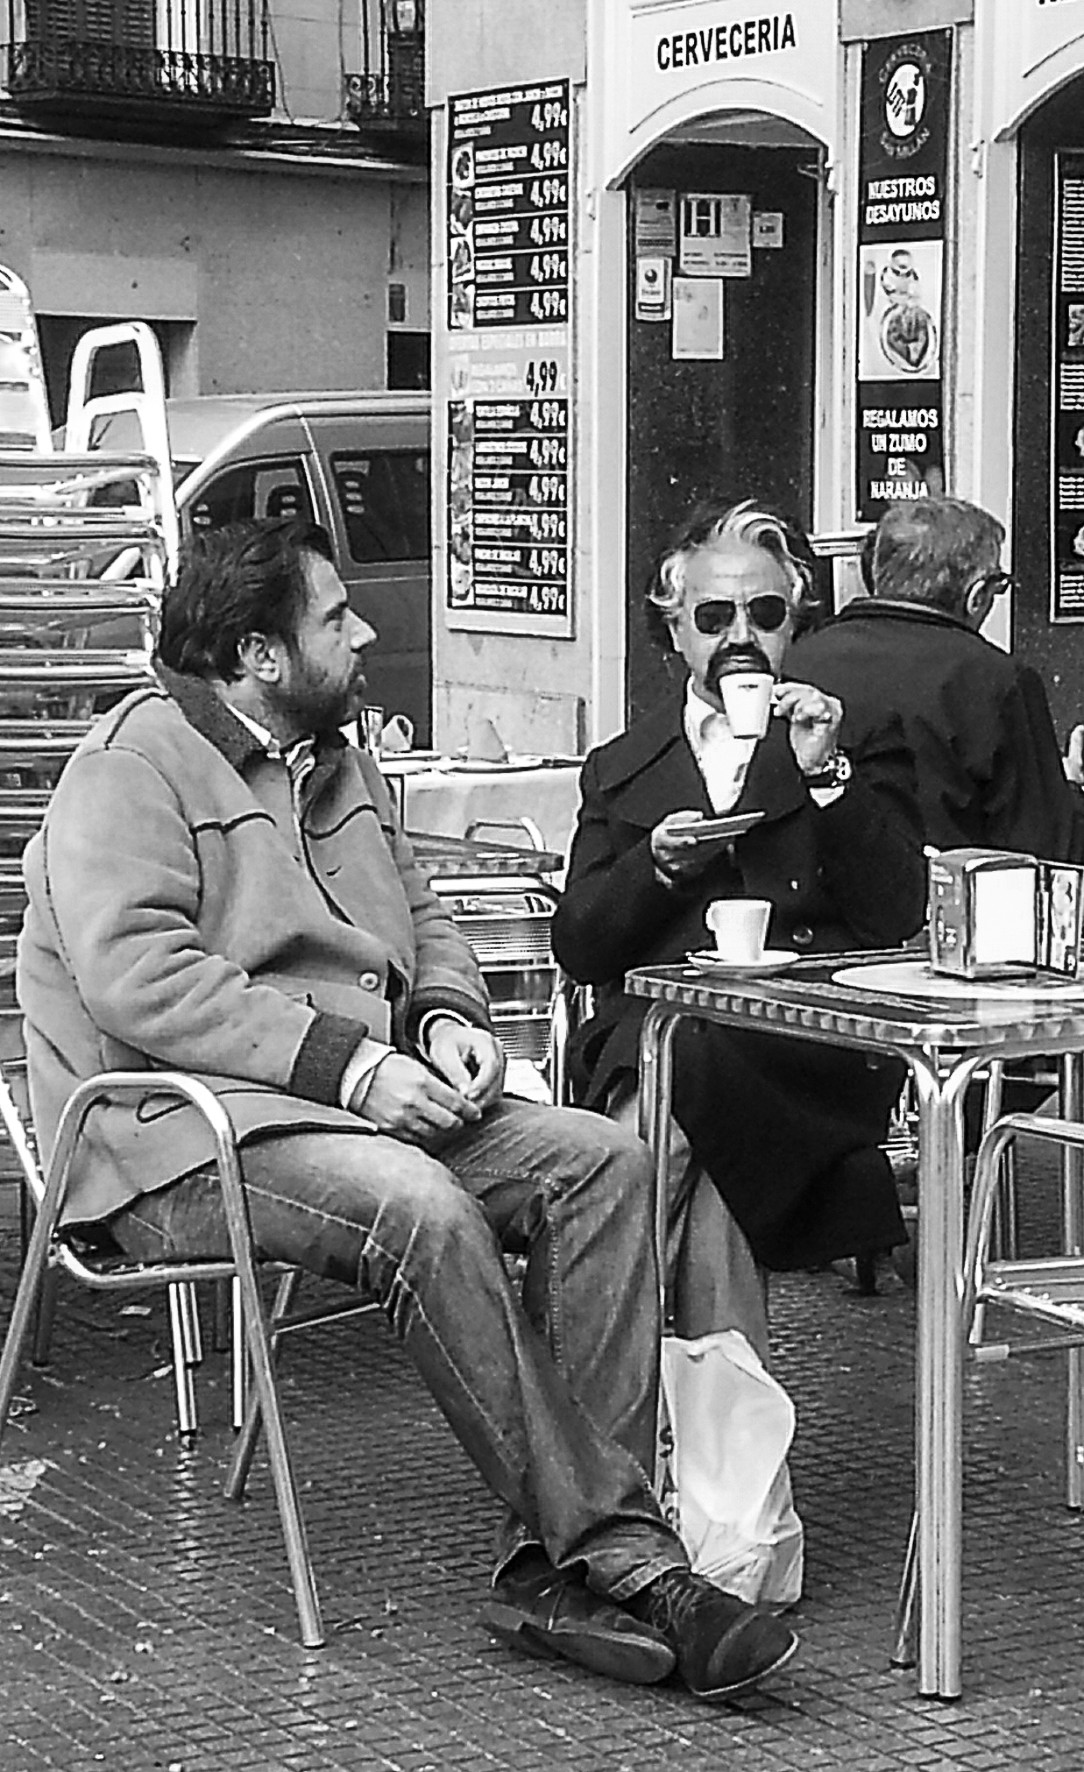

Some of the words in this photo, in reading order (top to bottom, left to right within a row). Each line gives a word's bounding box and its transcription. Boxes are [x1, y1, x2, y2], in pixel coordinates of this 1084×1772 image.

[657, 13, 796, 71] CERVECERIA
[868, 175, 936, 200] NUESTROS
[865, 200, 940, 225] DESAYUNOS
[862, 408, 938, 428] REGALAMOS
[871, 433, 887, 453] UN
[888, 433, 927, 453] ZUMO
[887, 457, 907, 476] DE
[870, 481, 929, 500] NARANJA
